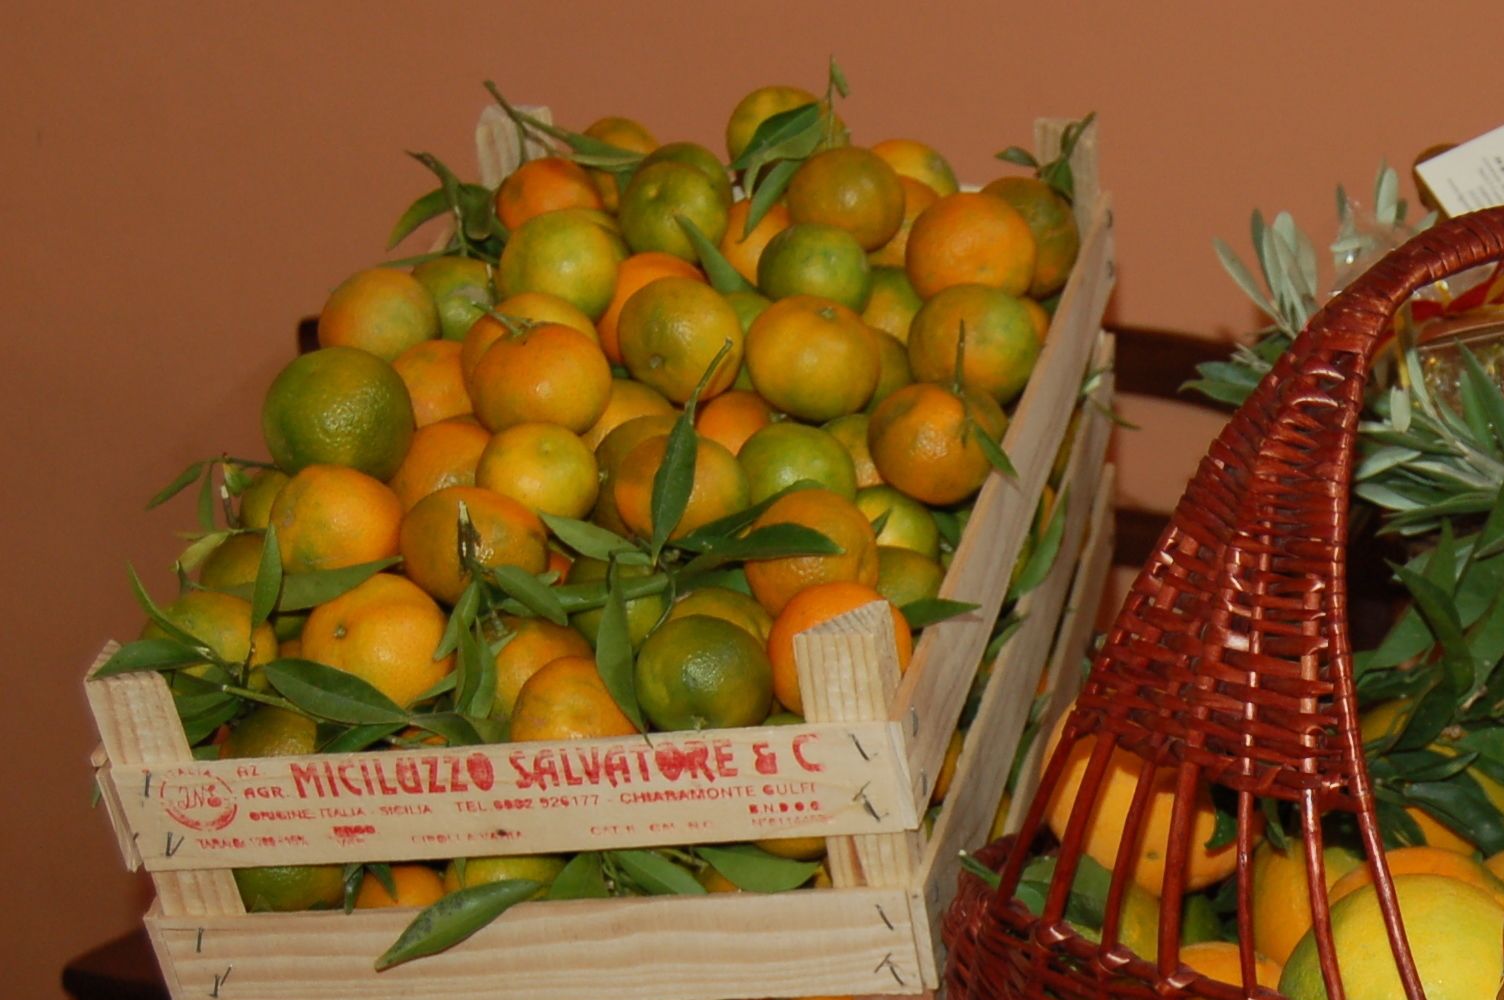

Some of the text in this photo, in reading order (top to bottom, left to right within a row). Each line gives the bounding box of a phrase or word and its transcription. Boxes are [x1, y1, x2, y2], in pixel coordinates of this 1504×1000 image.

[290, 752, 494, 798] MICILUZZO
[509, 739, 738, 791] SALVATORE
[752, 742, 778, 775] &
[320, 807, 366, 819] ITALIA
[380, 805, 433, 816] SICILIA
[620, 785, 756, 805] CHIARAMONTE
